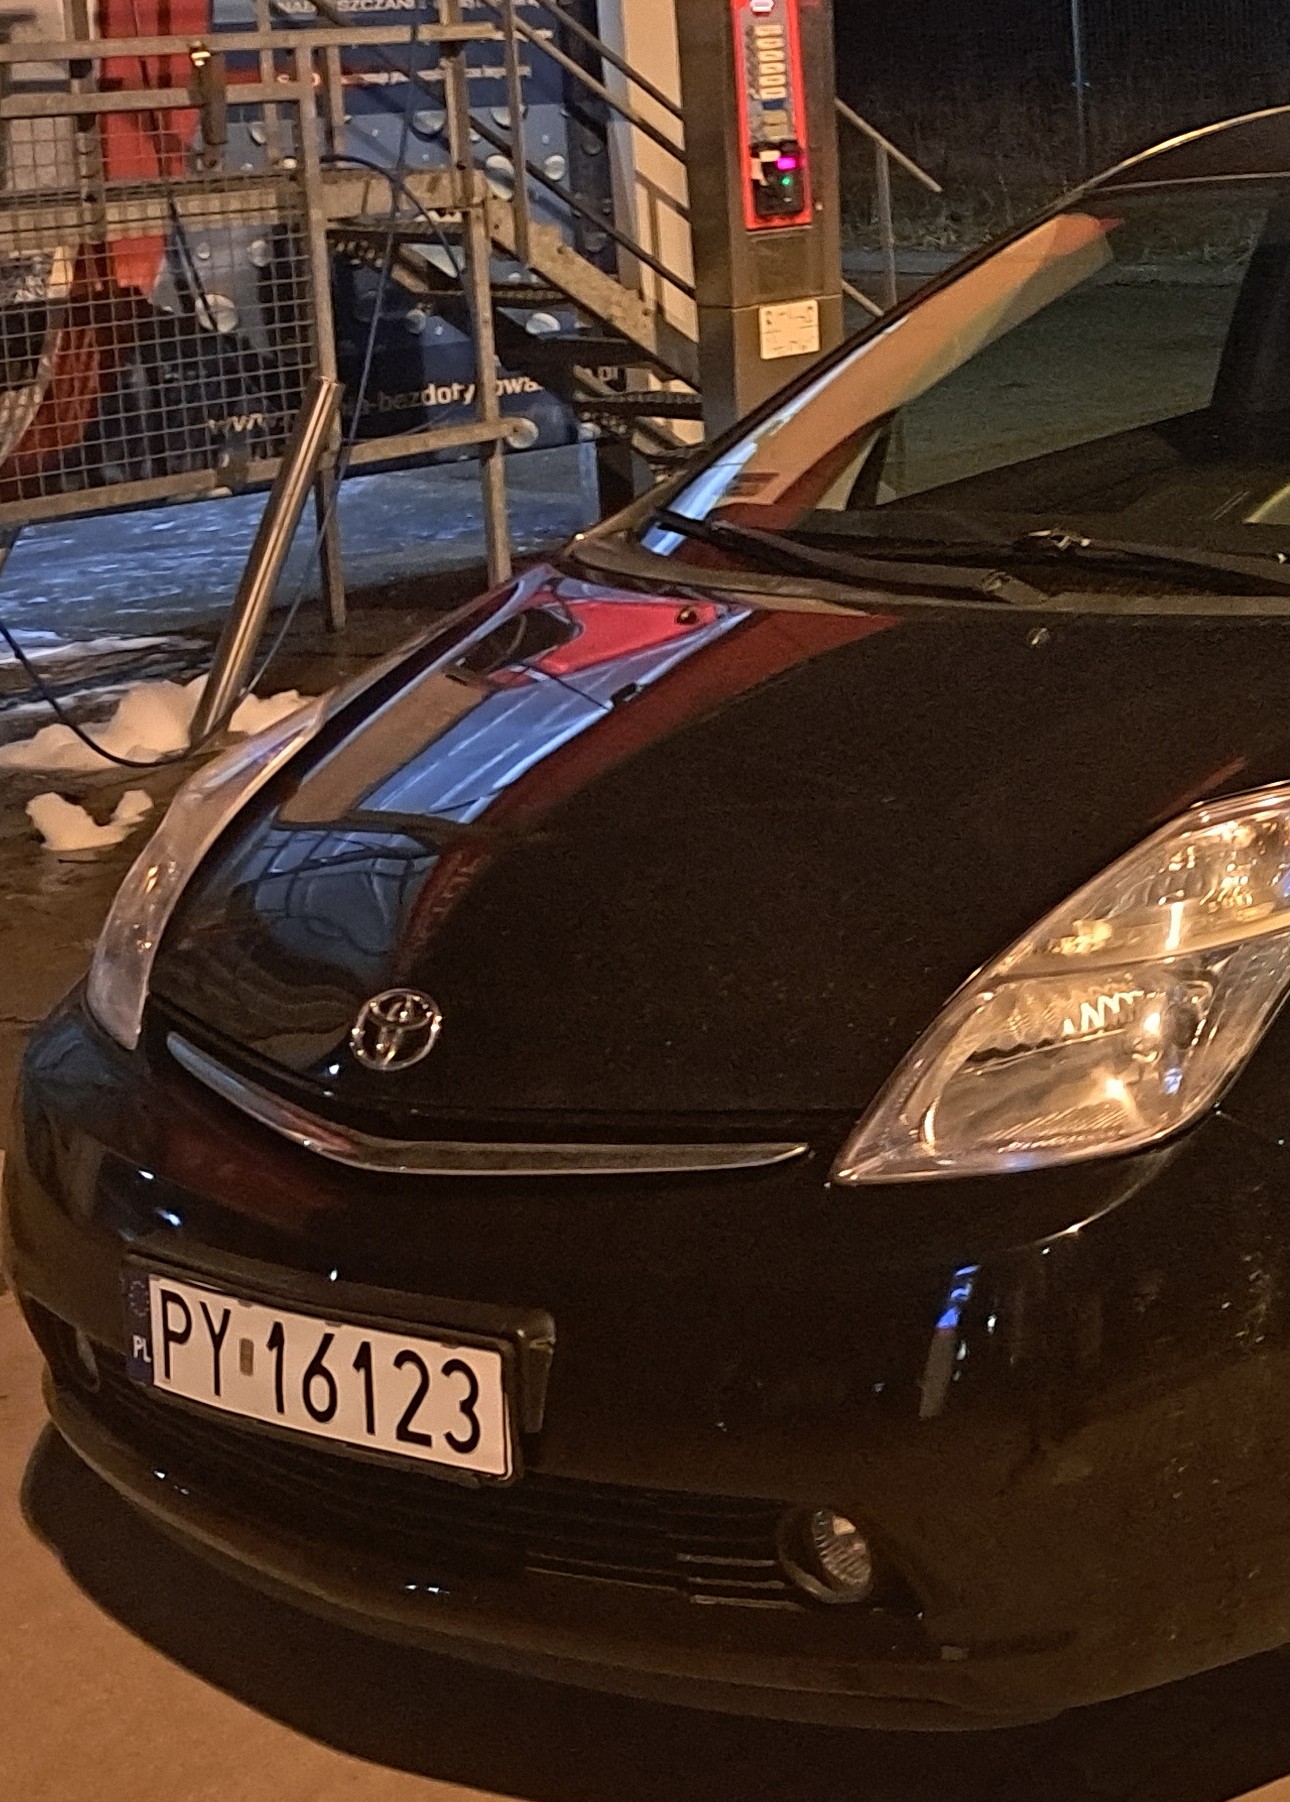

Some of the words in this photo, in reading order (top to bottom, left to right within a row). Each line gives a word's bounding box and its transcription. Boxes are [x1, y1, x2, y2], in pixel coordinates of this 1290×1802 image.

[133, 1335, 152, 1363] PL
[160, 1288, 231, 1397] PY
[266, 1320, 481, 1454] 16123
